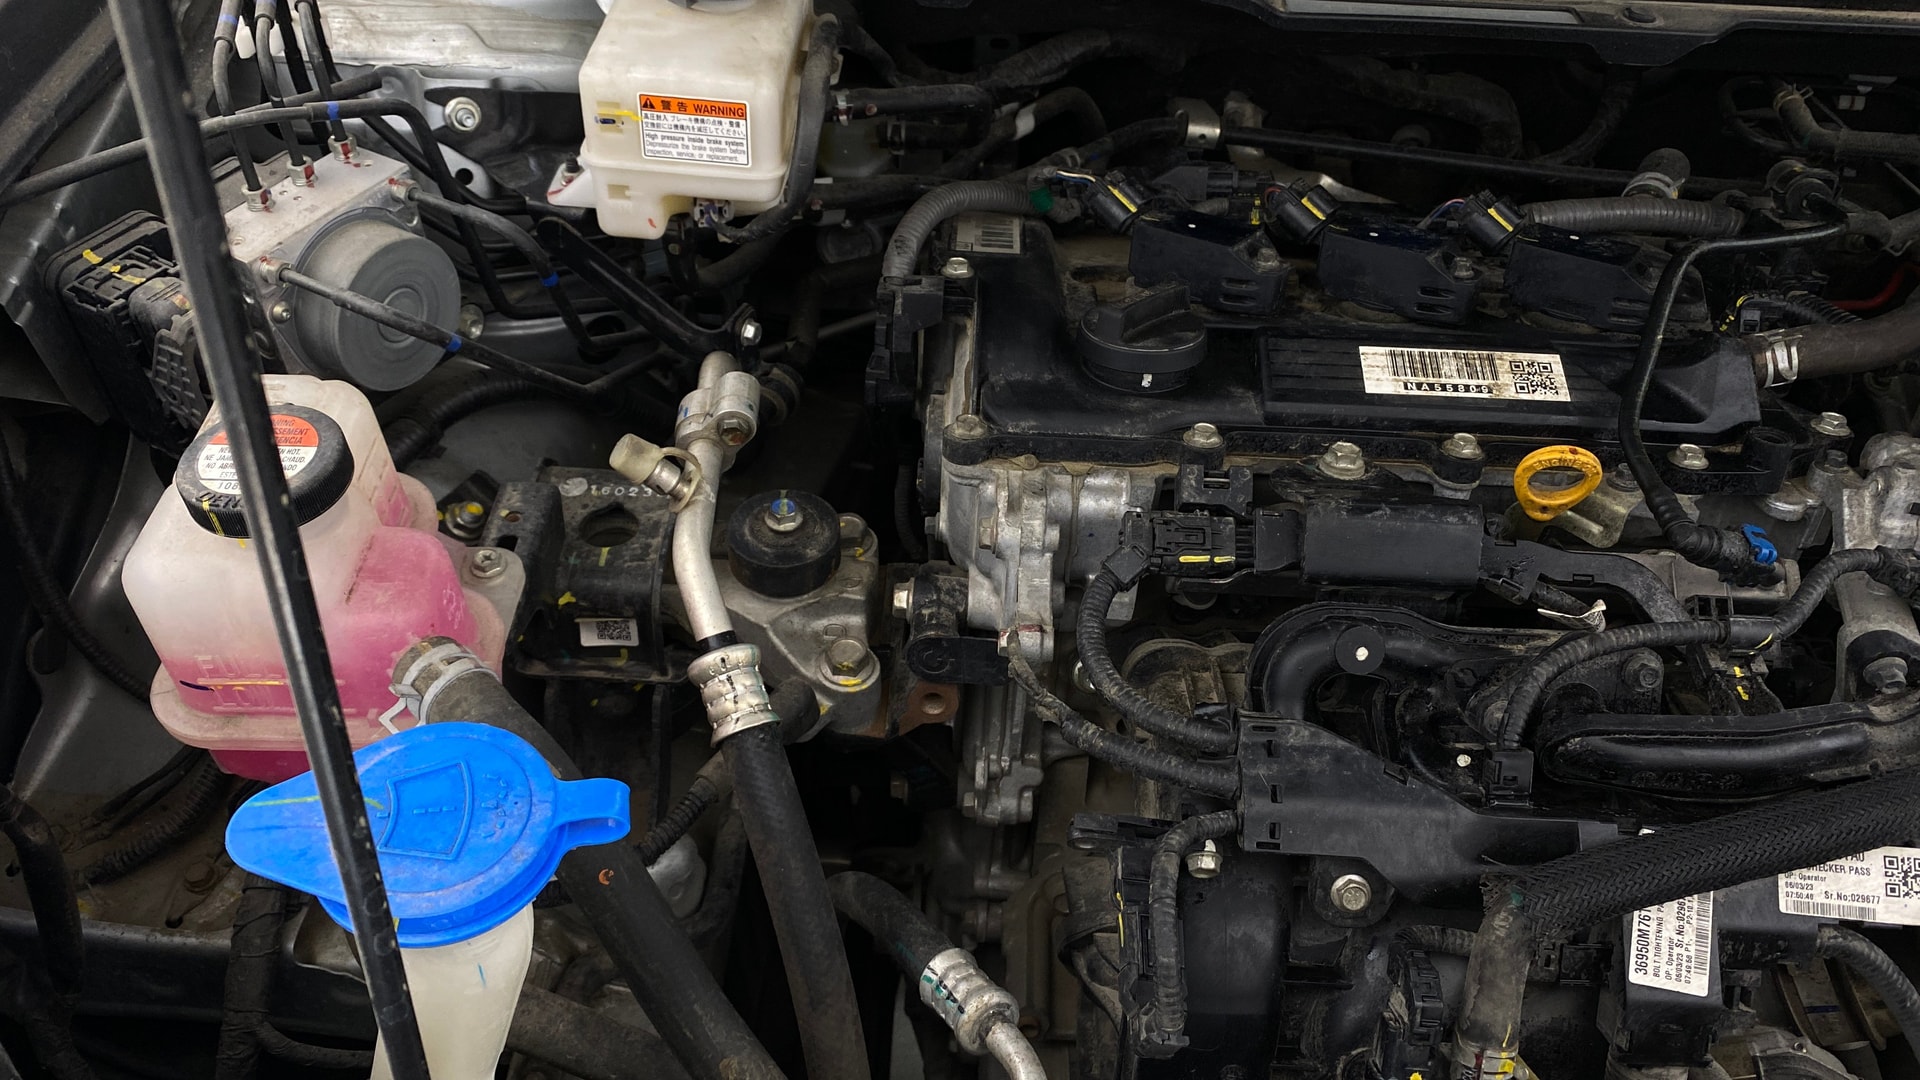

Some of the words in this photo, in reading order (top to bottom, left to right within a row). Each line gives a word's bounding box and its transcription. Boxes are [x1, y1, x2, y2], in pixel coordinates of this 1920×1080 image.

[660, 99, 688, 112] 警告
[693, 104, 745, 117] WARNING
[645, 132, 658, 140] High
[661, 135, 684, 143] pressure
[709, 145, 728, 153] system
[730, 147, 746, 155] before
[218, 481, 240, 490] 108
[195, 492, 242, 508] DEN
[1798, 873, 1827, 882] Operator
[1849, 866, 1871, 876] PASS
[1675, 898, 1686, 948] Sr.No:0296
[1635, 908, 1652, 975] 36950M76T
[1654, 916, 1664, 958] TIGHTENING
[1665, 936, 1675, 966] Operator
[1653, 960, 1661, 978] BOLT
